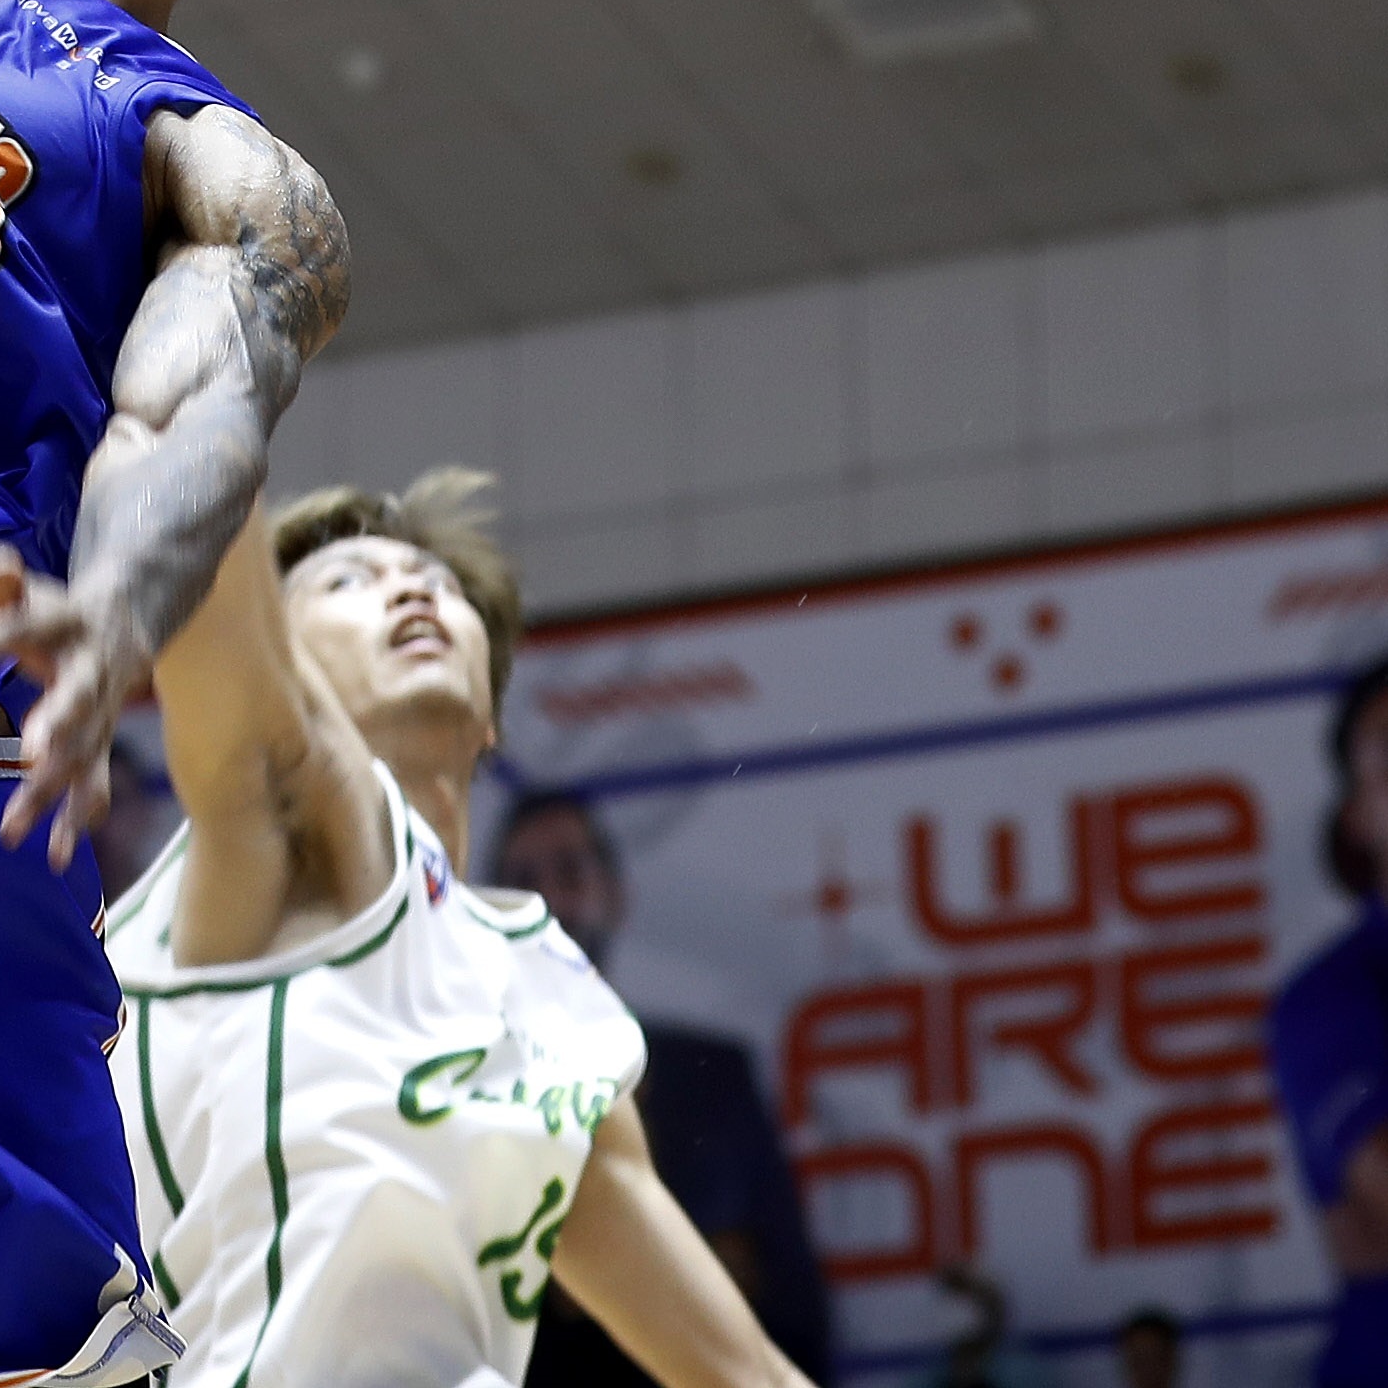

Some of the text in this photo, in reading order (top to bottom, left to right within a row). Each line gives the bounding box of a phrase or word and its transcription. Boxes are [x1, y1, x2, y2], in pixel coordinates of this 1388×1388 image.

[906, 770, 1266, 948] WE
[780, 932, 1268, 1128] ARE
[786, 1094, 1280, 1286] ONE
